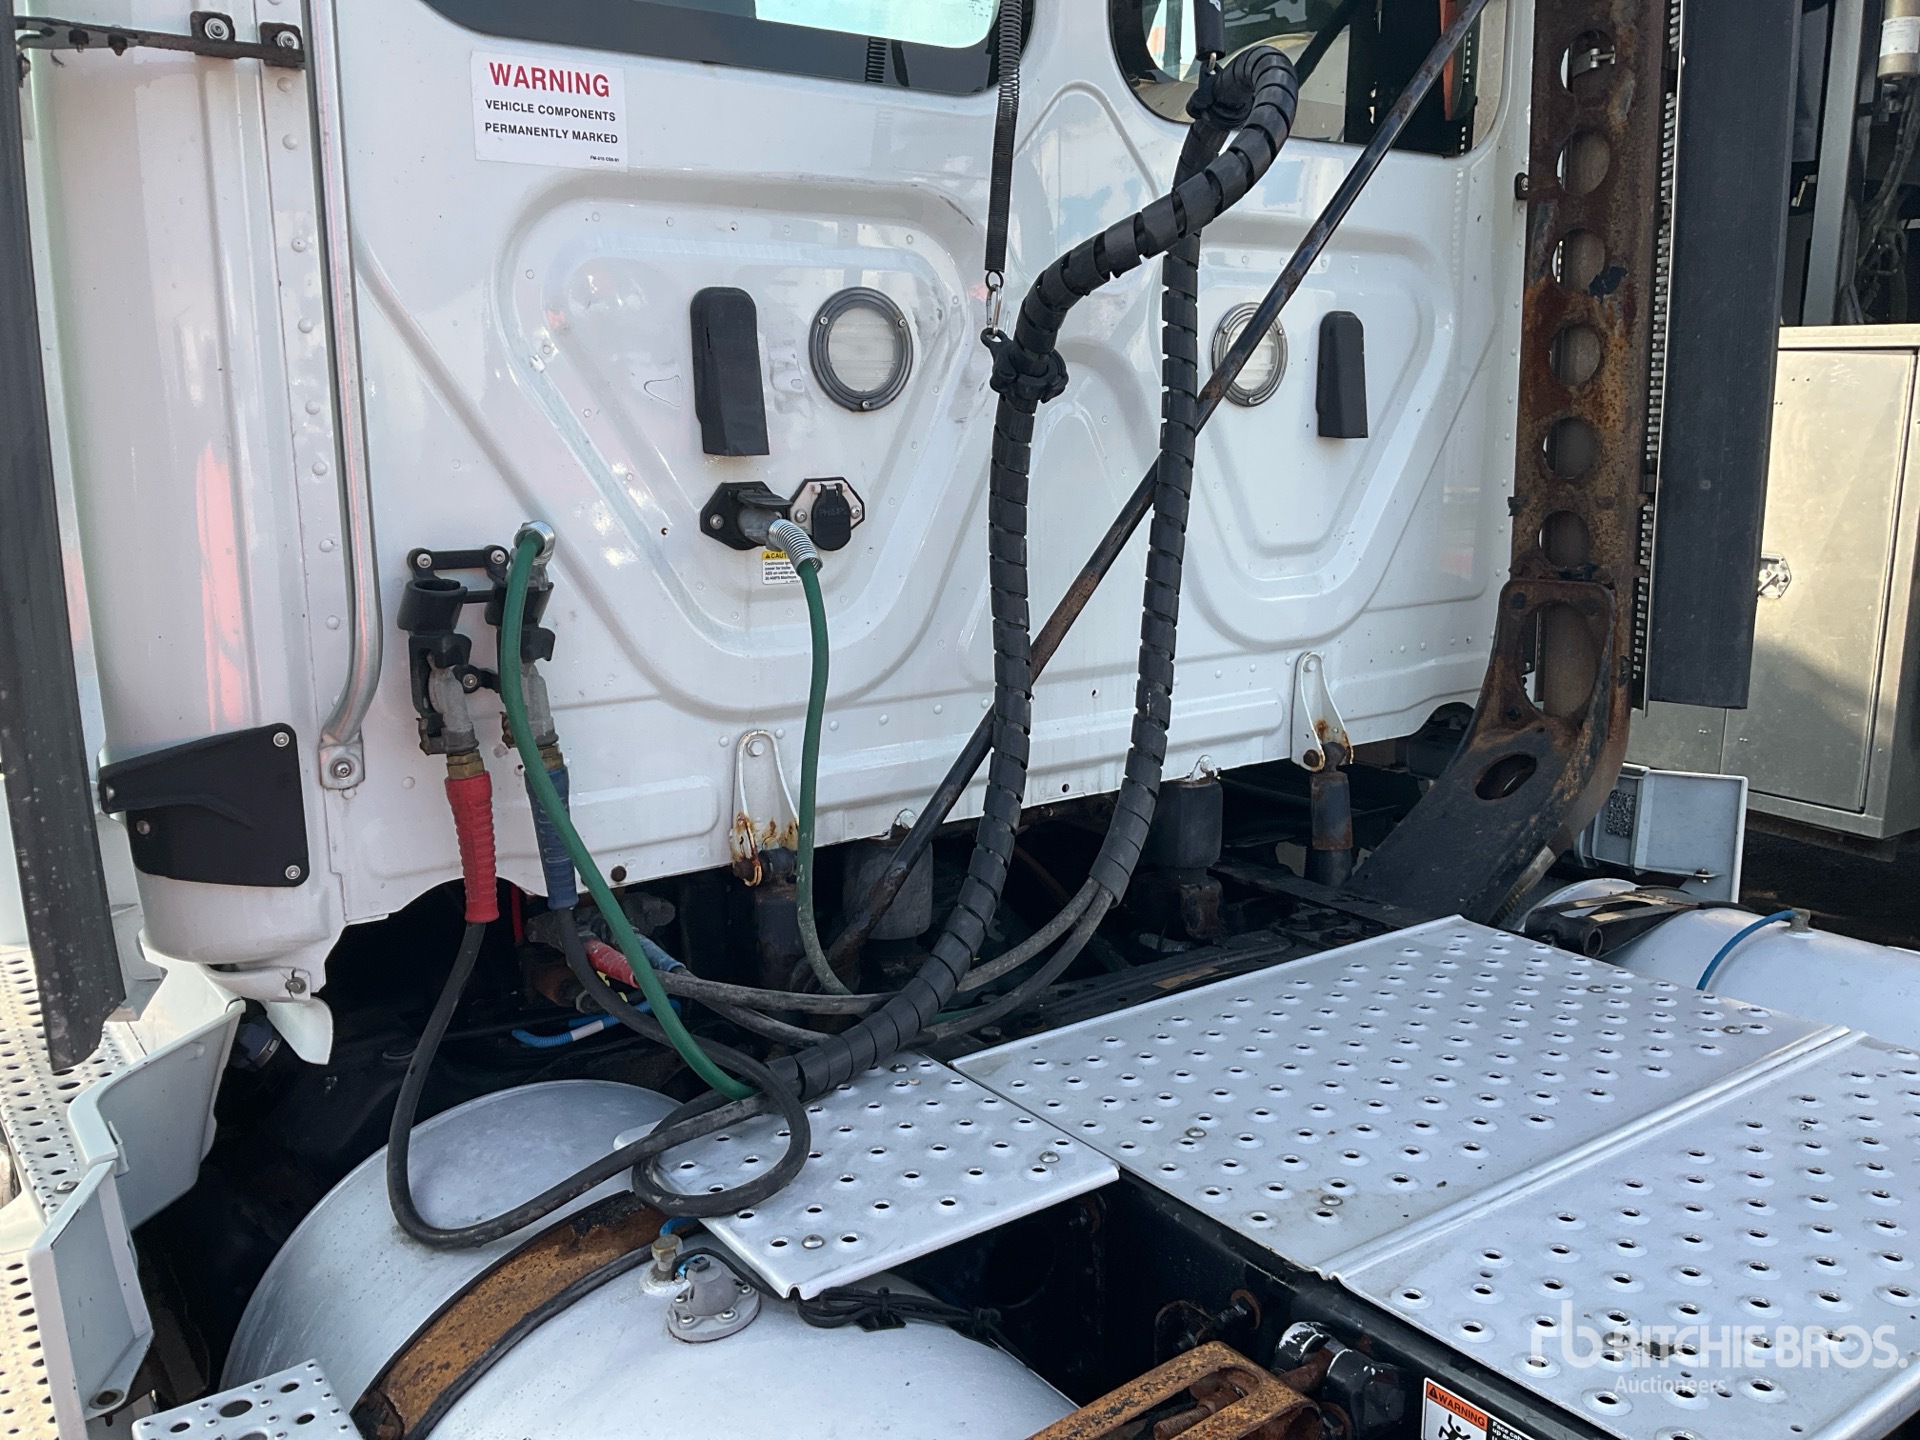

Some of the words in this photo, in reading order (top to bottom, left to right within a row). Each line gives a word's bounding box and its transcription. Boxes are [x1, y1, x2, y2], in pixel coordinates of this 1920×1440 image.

[489, 62, 609, 97] WARNING
[485, 99, 534, 113] VEHICLE
[538, 105, 616, 121] COMPONENTS
[485, 122, 569, 139] PERMANENTLY
[572, 131, 618, 144] MARKED
[1439, 1393, 1485, 1427] WARNING
[1492, 1421, 1509, 1434] Face
[1492, 1428, 1502, 1436] up
